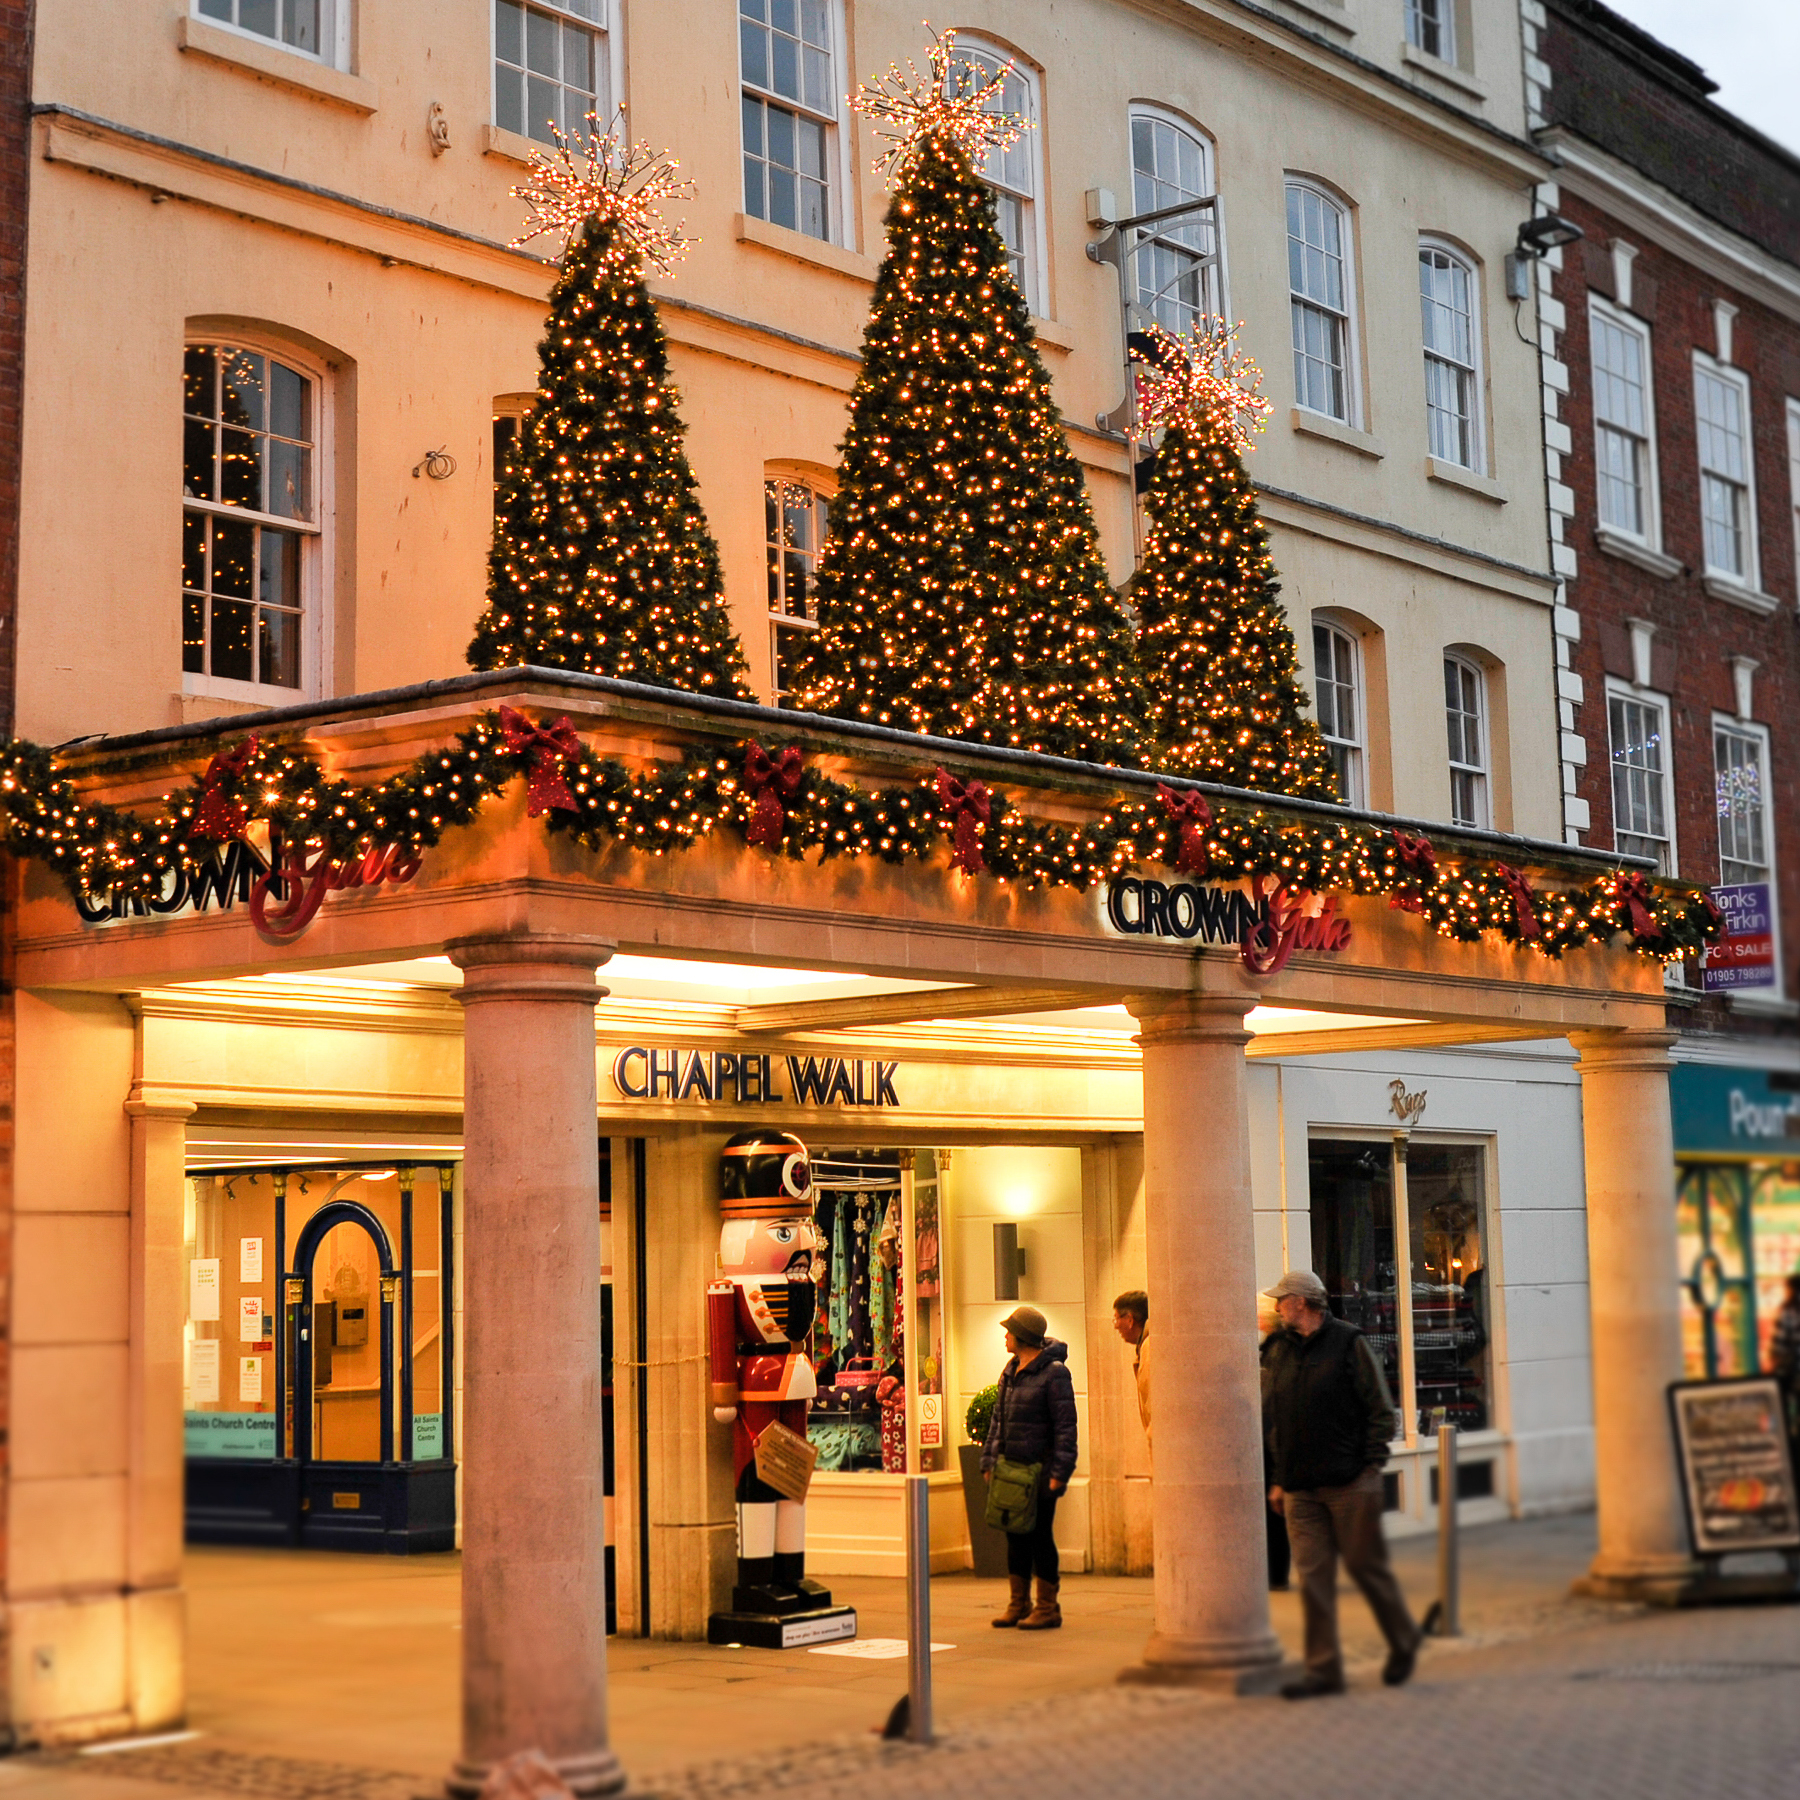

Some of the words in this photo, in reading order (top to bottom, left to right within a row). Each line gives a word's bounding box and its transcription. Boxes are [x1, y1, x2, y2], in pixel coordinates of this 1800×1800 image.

[1711, 888, 1757, 910] Tonks
[1107, 877, 1271, 948] CROWN
[1240, 872, 1352, 975] Gate
[1725, 909, 1766, 930] Firkin
[1735, 943, 1772, 957] SALE
[1707, 970, 1735, 983] 01905
[613, 1046, 783, 1102] CHAPEL
[786, 1055, 900, 1107] WALK
[211, 1417, 244, 1430] Church
[246, 1417, 275, 1430] Centre
